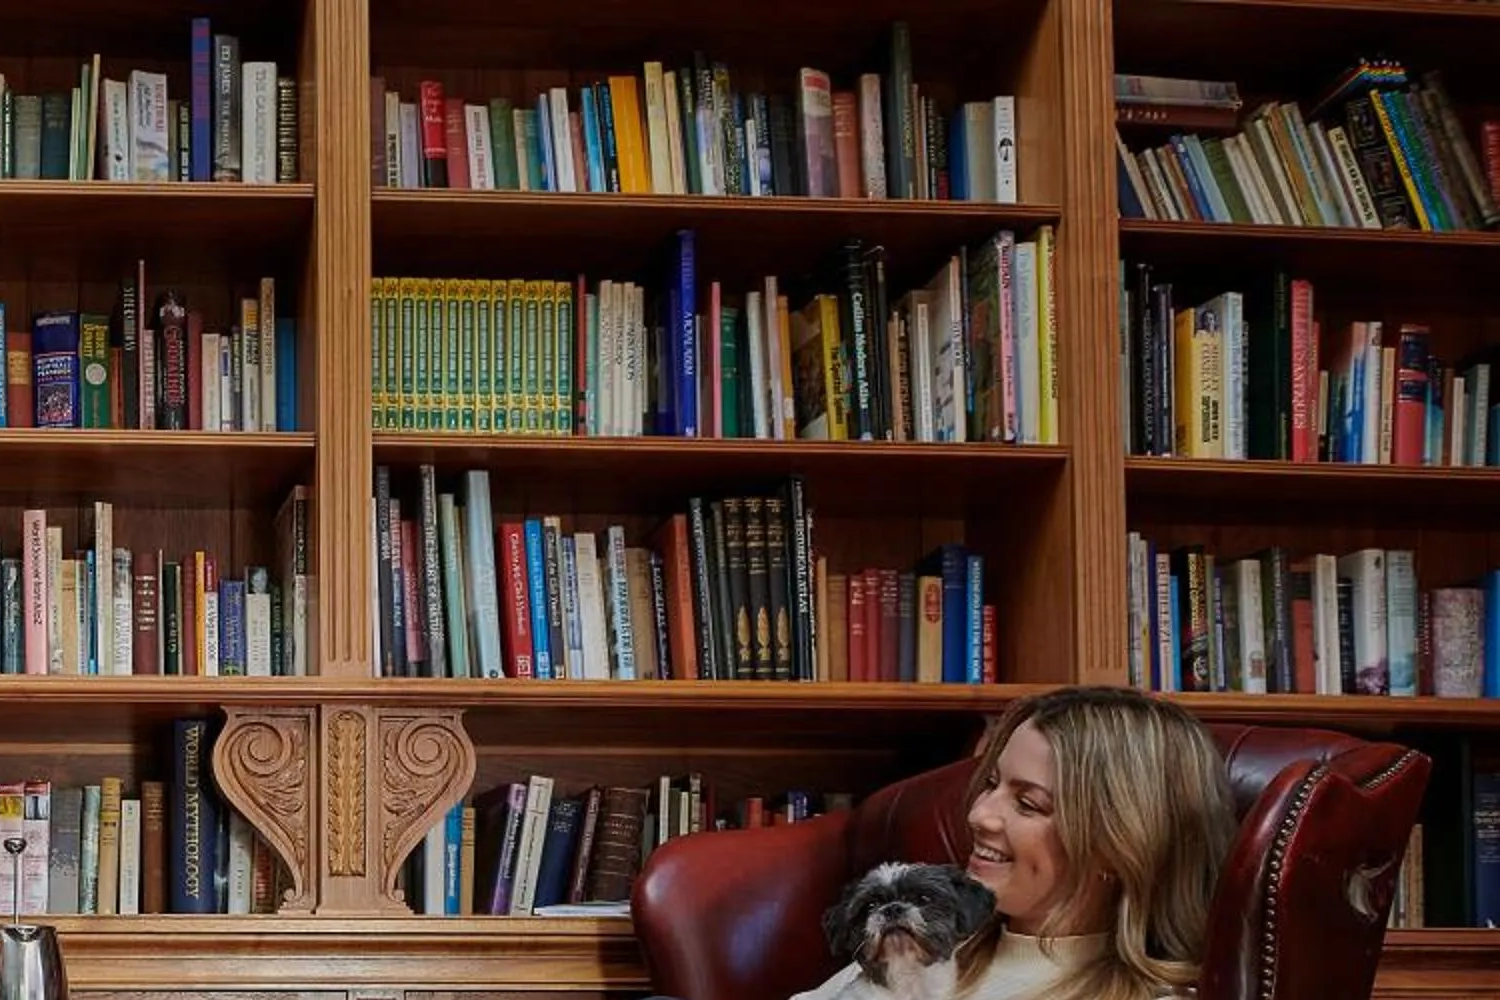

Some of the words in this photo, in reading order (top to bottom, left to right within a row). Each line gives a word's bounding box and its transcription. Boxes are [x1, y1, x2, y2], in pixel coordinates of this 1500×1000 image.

[859, 379, 869, 409] Atlas
[1293, 365, 1307, 429] ANTIQUES
[206, 611, 216, 639] Vegas
[185, 726, 199, 787] WORLD
[185, 791, 199, 899] MYTHOLOGY
